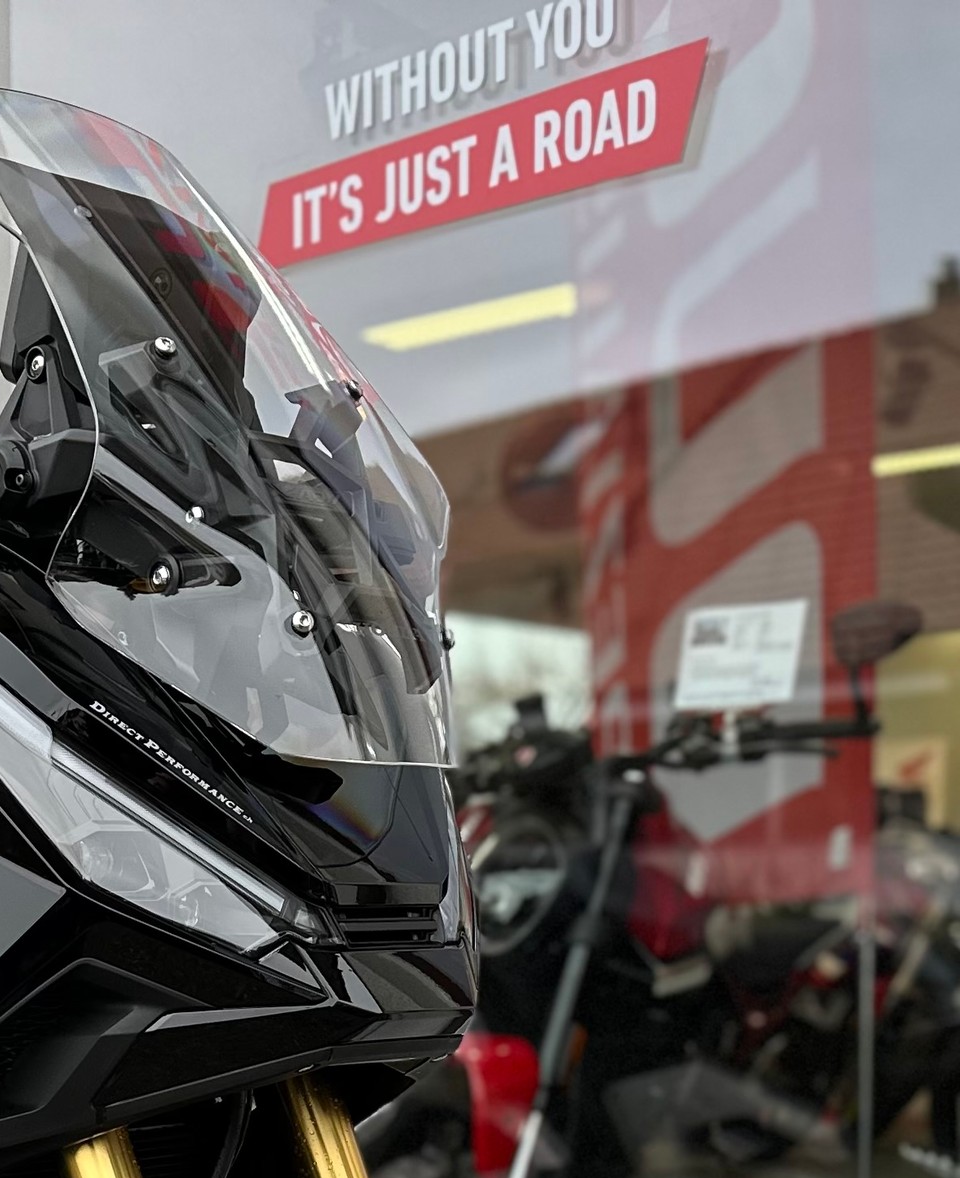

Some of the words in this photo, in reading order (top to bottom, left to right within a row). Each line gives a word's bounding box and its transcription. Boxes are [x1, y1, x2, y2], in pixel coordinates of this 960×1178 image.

[324, 17, 515, 140] WITHOUT
[526, 0, 618, 70] YOU
[291, 173, 363, 250] IT'S
[375, 134, 477, 224] JUST
[488, 123, 519, 188] A
[533, 78, 657, 174] ROAD
[89, 700, 145, 742] DIRECT
